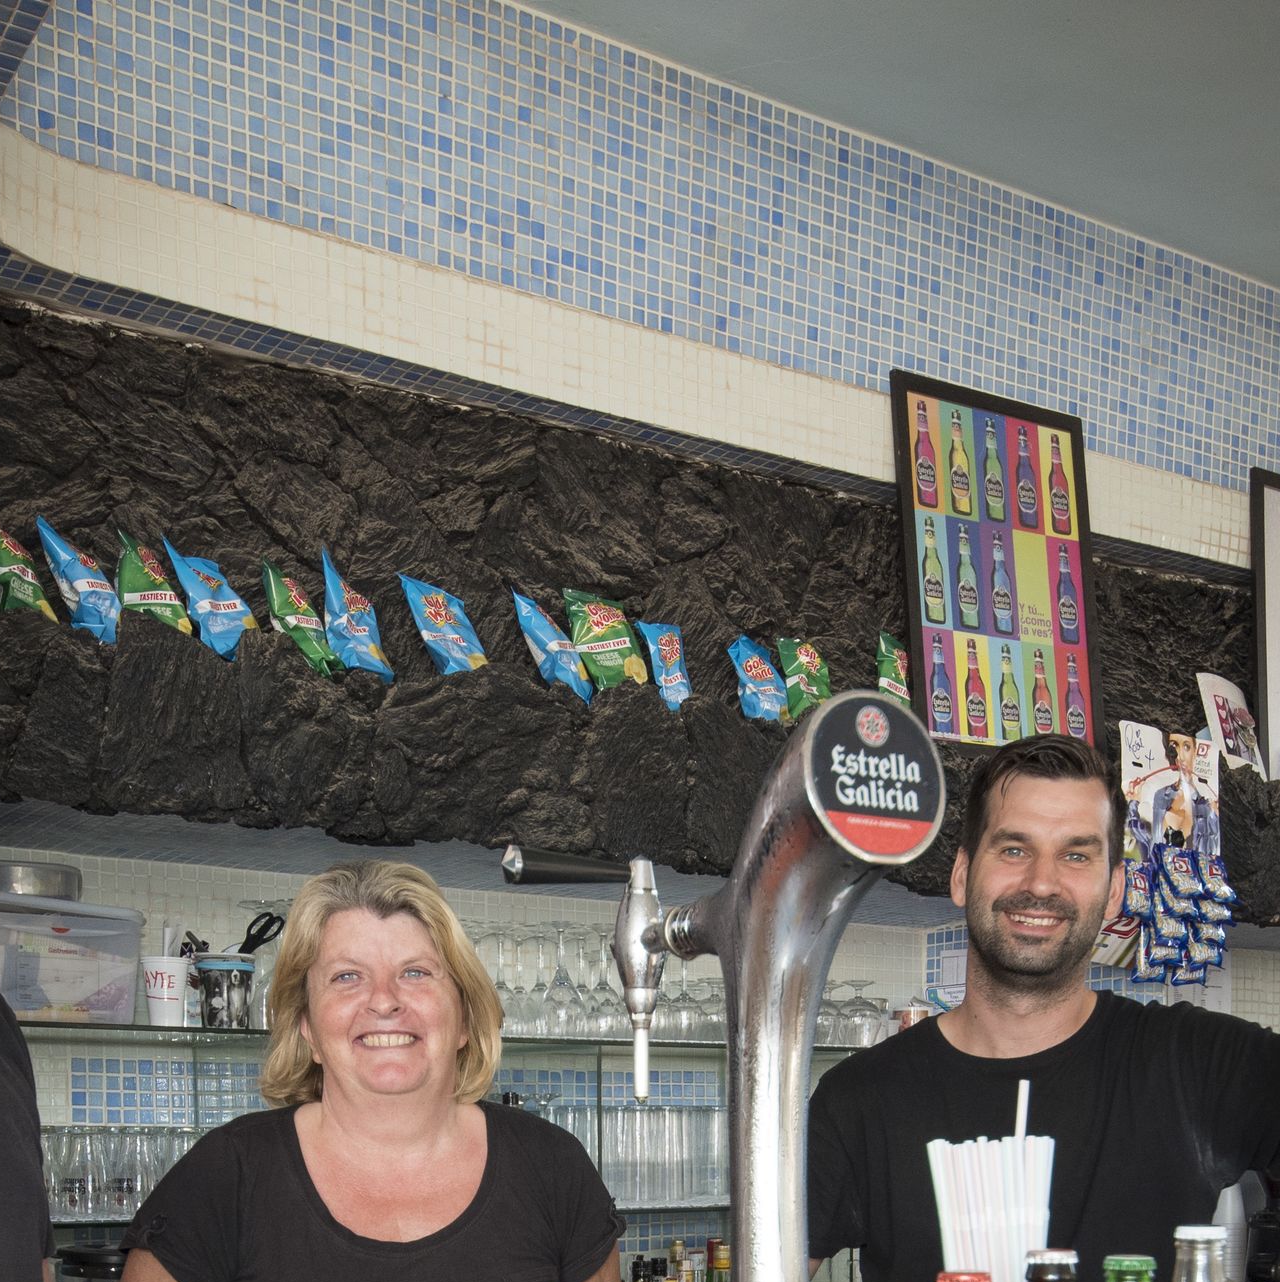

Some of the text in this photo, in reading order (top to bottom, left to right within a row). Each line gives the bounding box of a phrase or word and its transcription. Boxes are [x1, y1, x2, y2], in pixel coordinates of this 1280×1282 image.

[139, 592, 167, 601] TASTIEST
[587, 639, 627, 651] TASTIEST EVER
[831, 744, 922, 784] Estrella
[835, 775, 920, 813] Galicia
